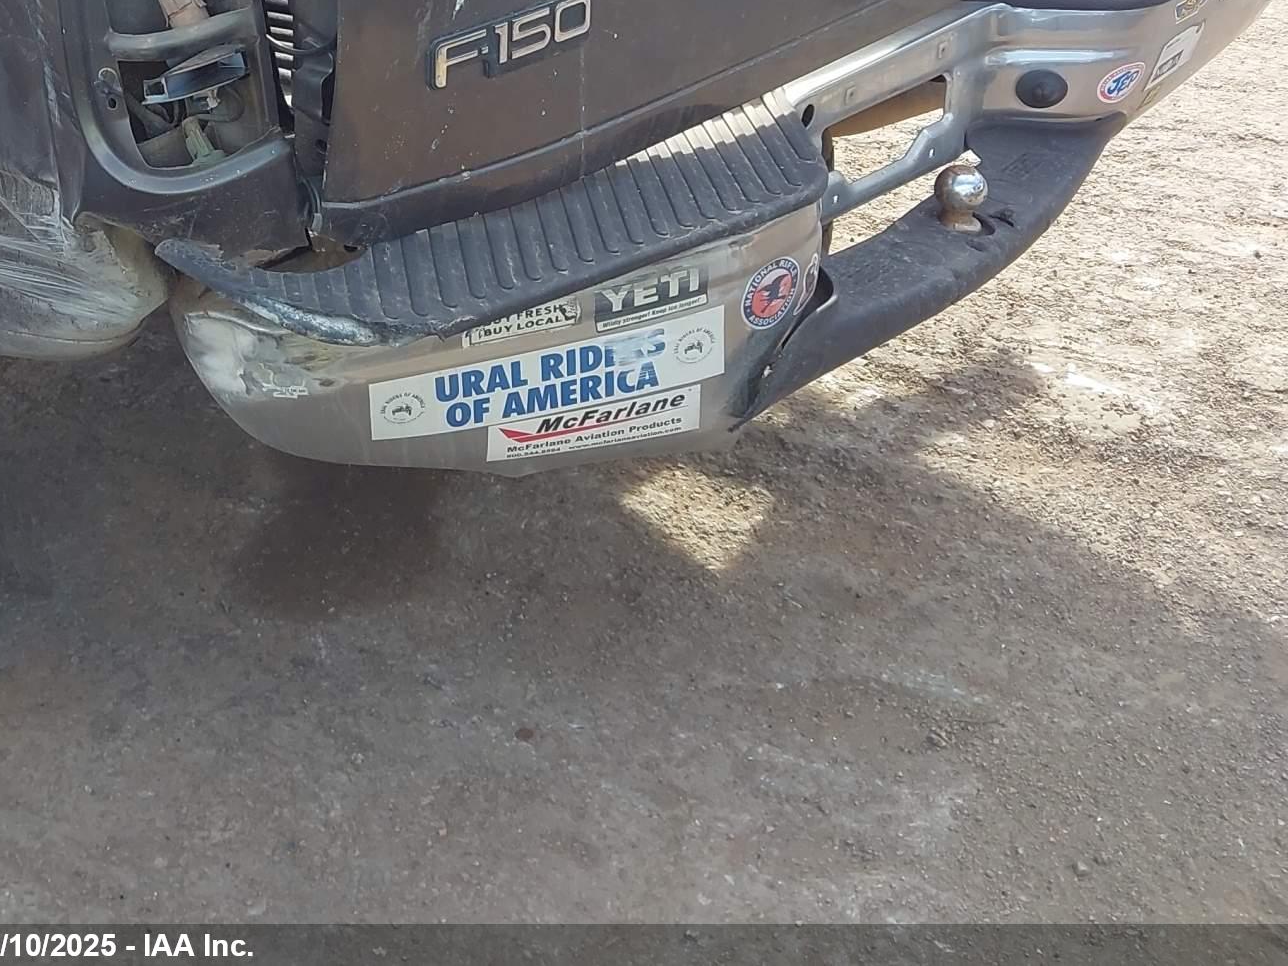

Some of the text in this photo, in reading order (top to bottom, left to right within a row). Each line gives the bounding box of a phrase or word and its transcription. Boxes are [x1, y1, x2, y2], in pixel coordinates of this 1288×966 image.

[600, 268, 700, 312] YETI
[745, 263, 778, 307] NATIONAL
[484, 324, 512, 336] BUY
[517, 316, 563, 330] LOCAL
[435, 360, 528, 403] URAL
[446, 361, 660, 427] OF AMERICA
[536, 393, 686, 433] McFarlane
[506, 417, 682, 453] McFarlane Aviation Products
